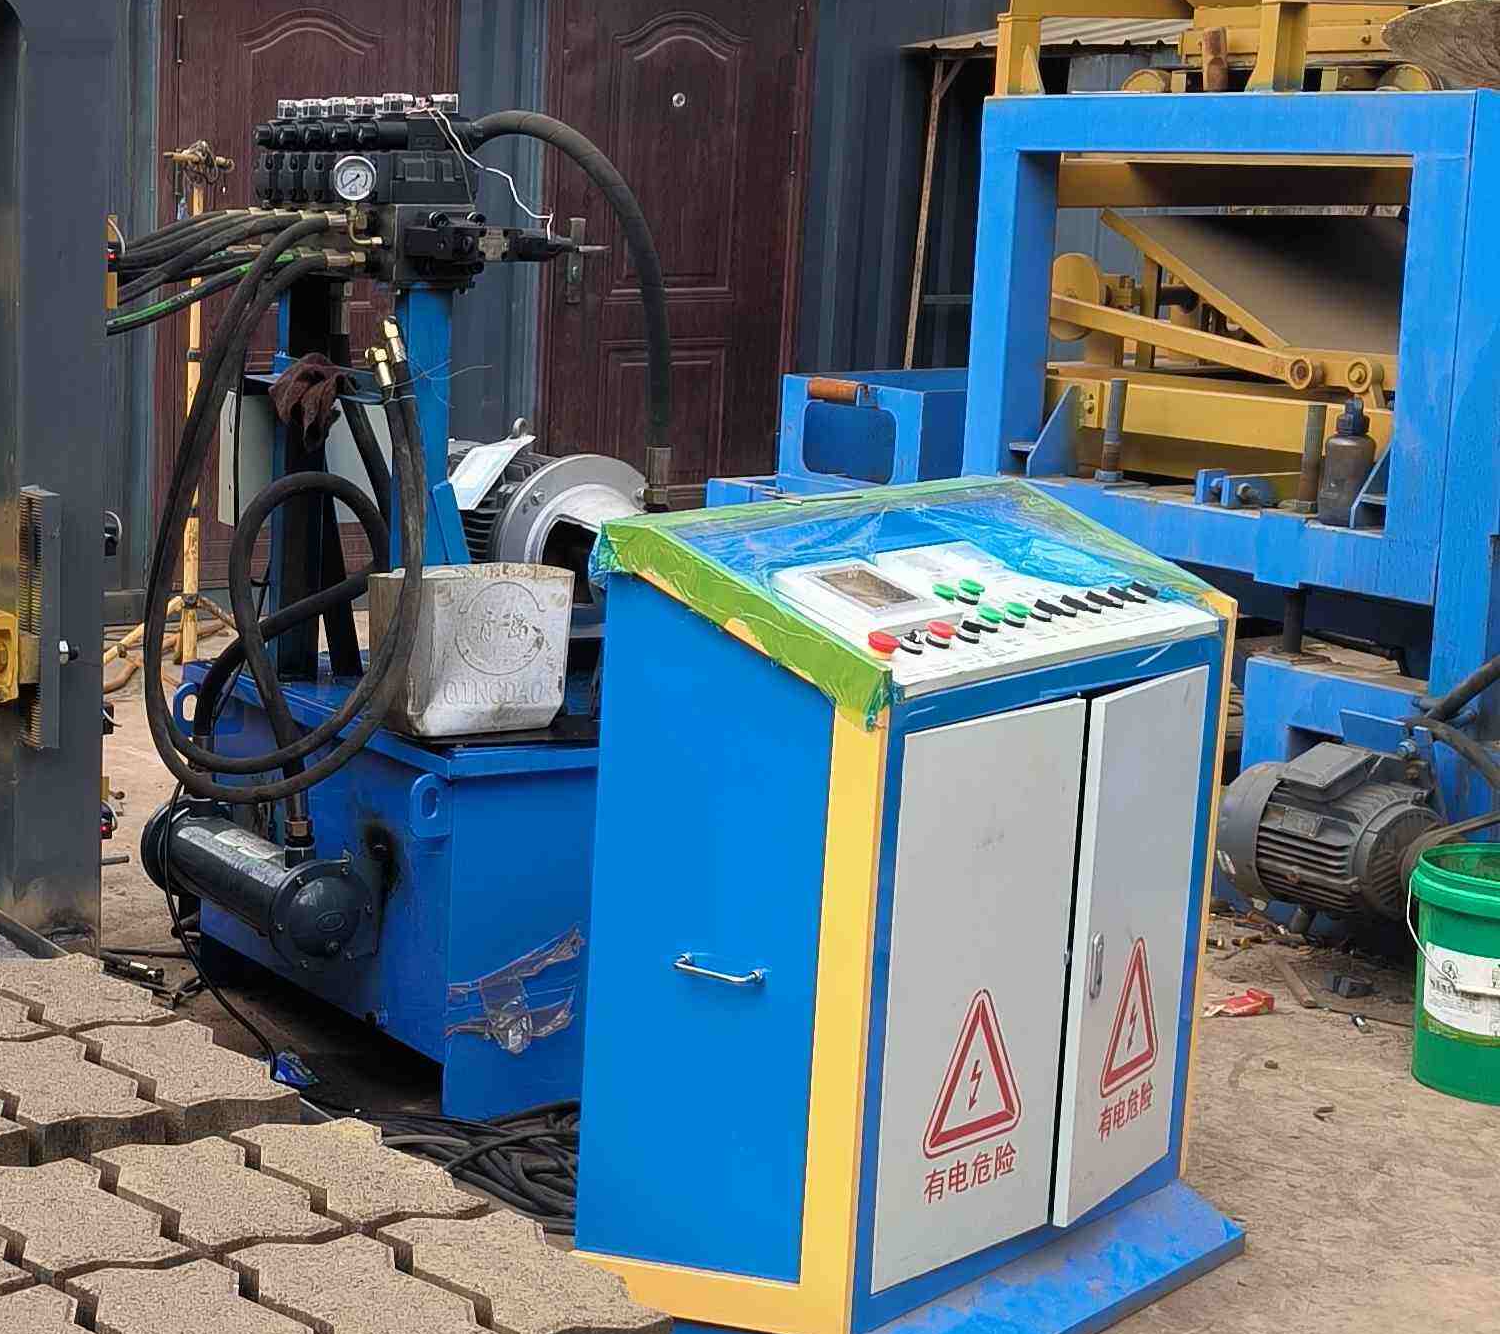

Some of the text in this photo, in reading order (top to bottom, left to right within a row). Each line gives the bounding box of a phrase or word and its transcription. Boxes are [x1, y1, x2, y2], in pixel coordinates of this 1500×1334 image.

[1098, 1077, 1153, 1142] 有电危险
[924, 1140, 1016, 1203] 有电危险
